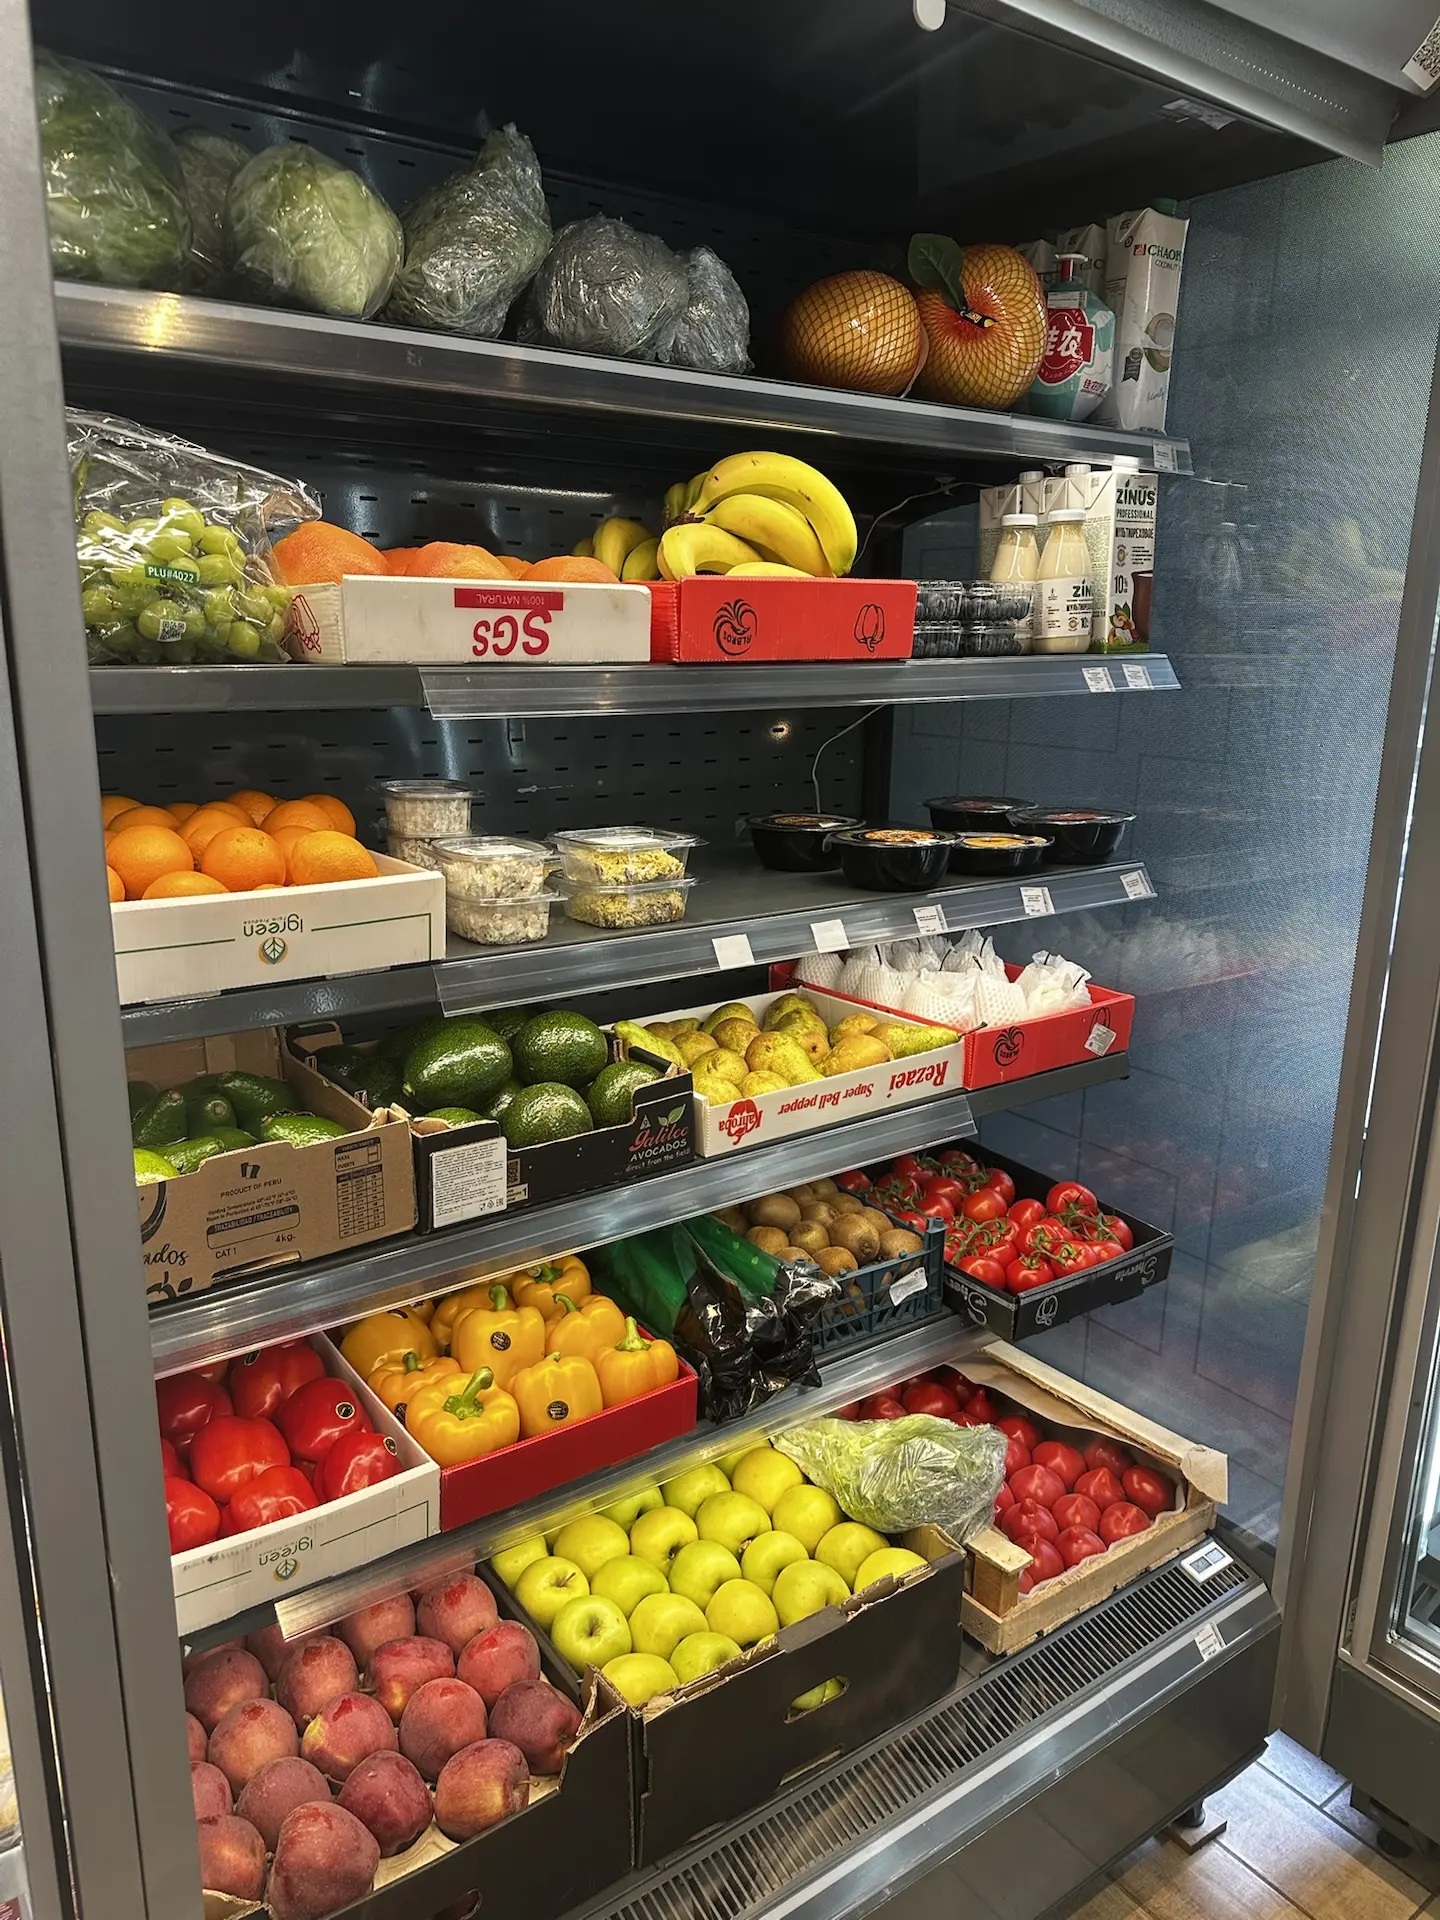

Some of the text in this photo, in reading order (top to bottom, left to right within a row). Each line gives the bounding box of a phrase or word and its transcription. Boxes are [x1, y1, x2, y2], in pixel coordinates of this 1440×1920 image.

[1116, 487, 1156, 506] ZINUS
[1116, 508, 1154, 519] PROFESSIONAL
[148, 566, 194, 583] PLU#4022
[476, 593, 545, 606] 100% NATURAL
[1072, 585, 1093, 597] ZIN
[472, 608, 552, 656] SGS
[723, 630, 752, 645] ALBROS
[243, 913, 303, 937] igreen
[887, 1060, 949, 1098] Rezaei
[777, 1083, 874, 1115] Super Bell pepper
[718, 1109, 763, 1132] Kahroba
[630, 1138, 687, 1162] AVOCADOS
[664, 1152, 673, 1161] the
[220, 1178, 282, 1198] PRODUCT OF PERU
[215, 1248, 232, 1259] CAT
[258, 1536, 314, 1566] igreen
